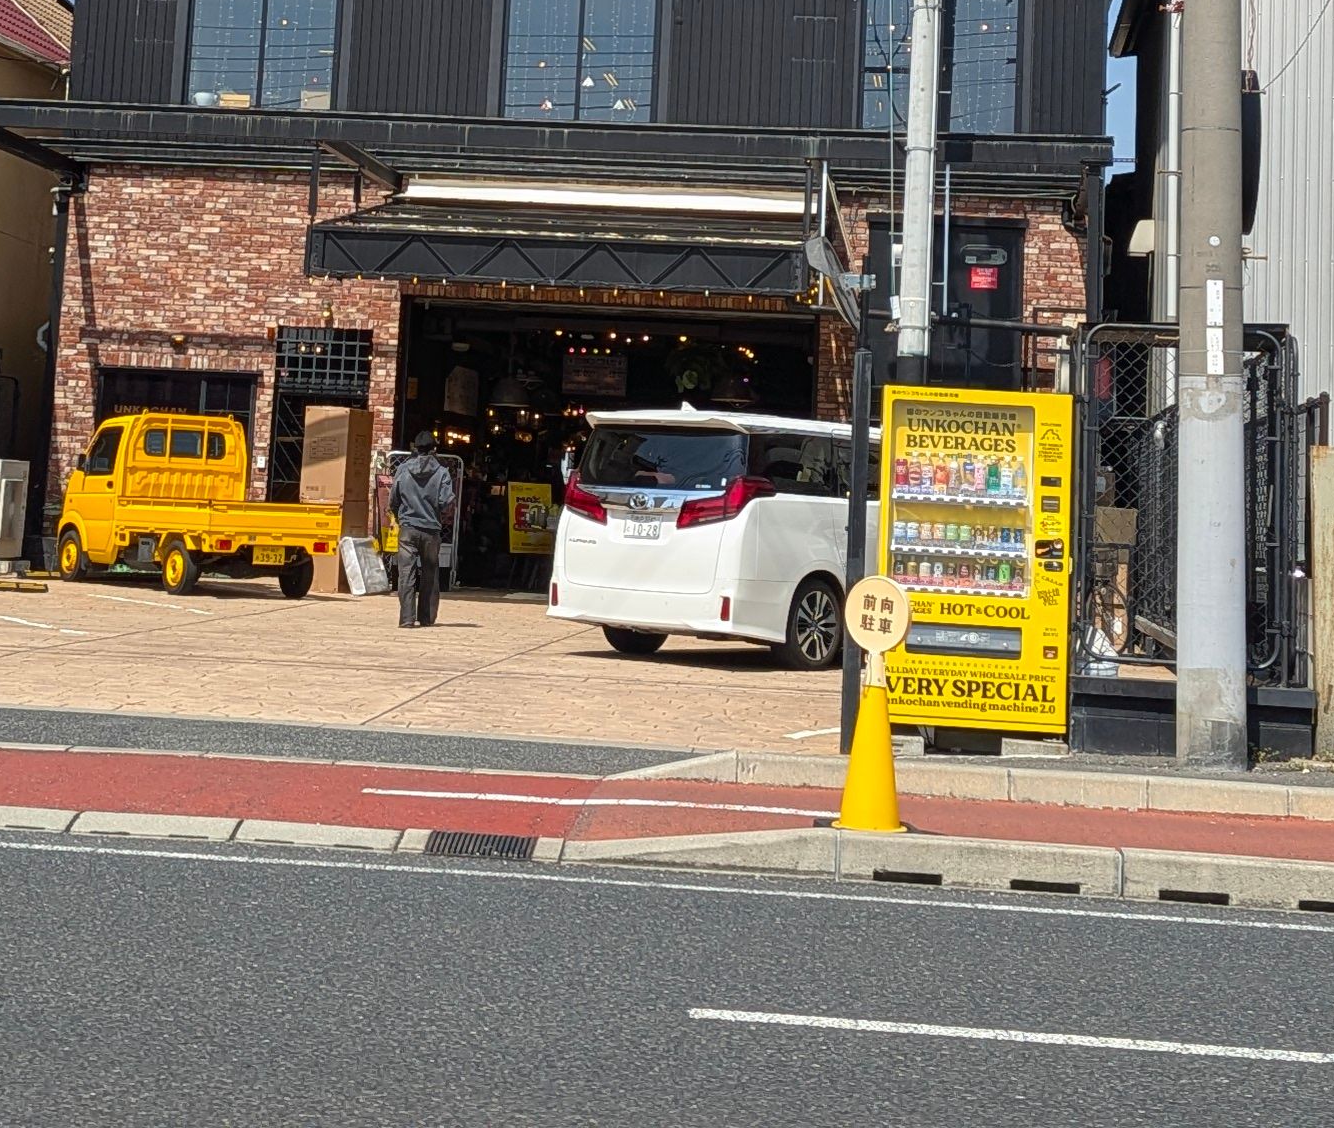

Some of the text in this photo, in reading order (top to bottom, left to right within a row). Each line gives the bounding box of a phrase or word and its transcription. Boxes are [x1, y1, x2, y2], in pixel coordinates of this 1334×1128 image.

[908, 418, 1015, 436] UNKOCHAN
[906, 434, 1016, 453] BEVERAGES
[863, 594, 894, 614] 前向
[860, 614, 892, 634] 駐車
[921, 668, 968, 678] EVERYDAY
[970, 671, 1027, 681] WHOLESALE
[1029, 674, 1056, 683] PRICE
[951, 680, 1055, 703] SPECIAL
[941, 697, 987, 712] vending
[988, 702, 1038, 713] machine
[1039, 704, 1056, 714] 2.0
